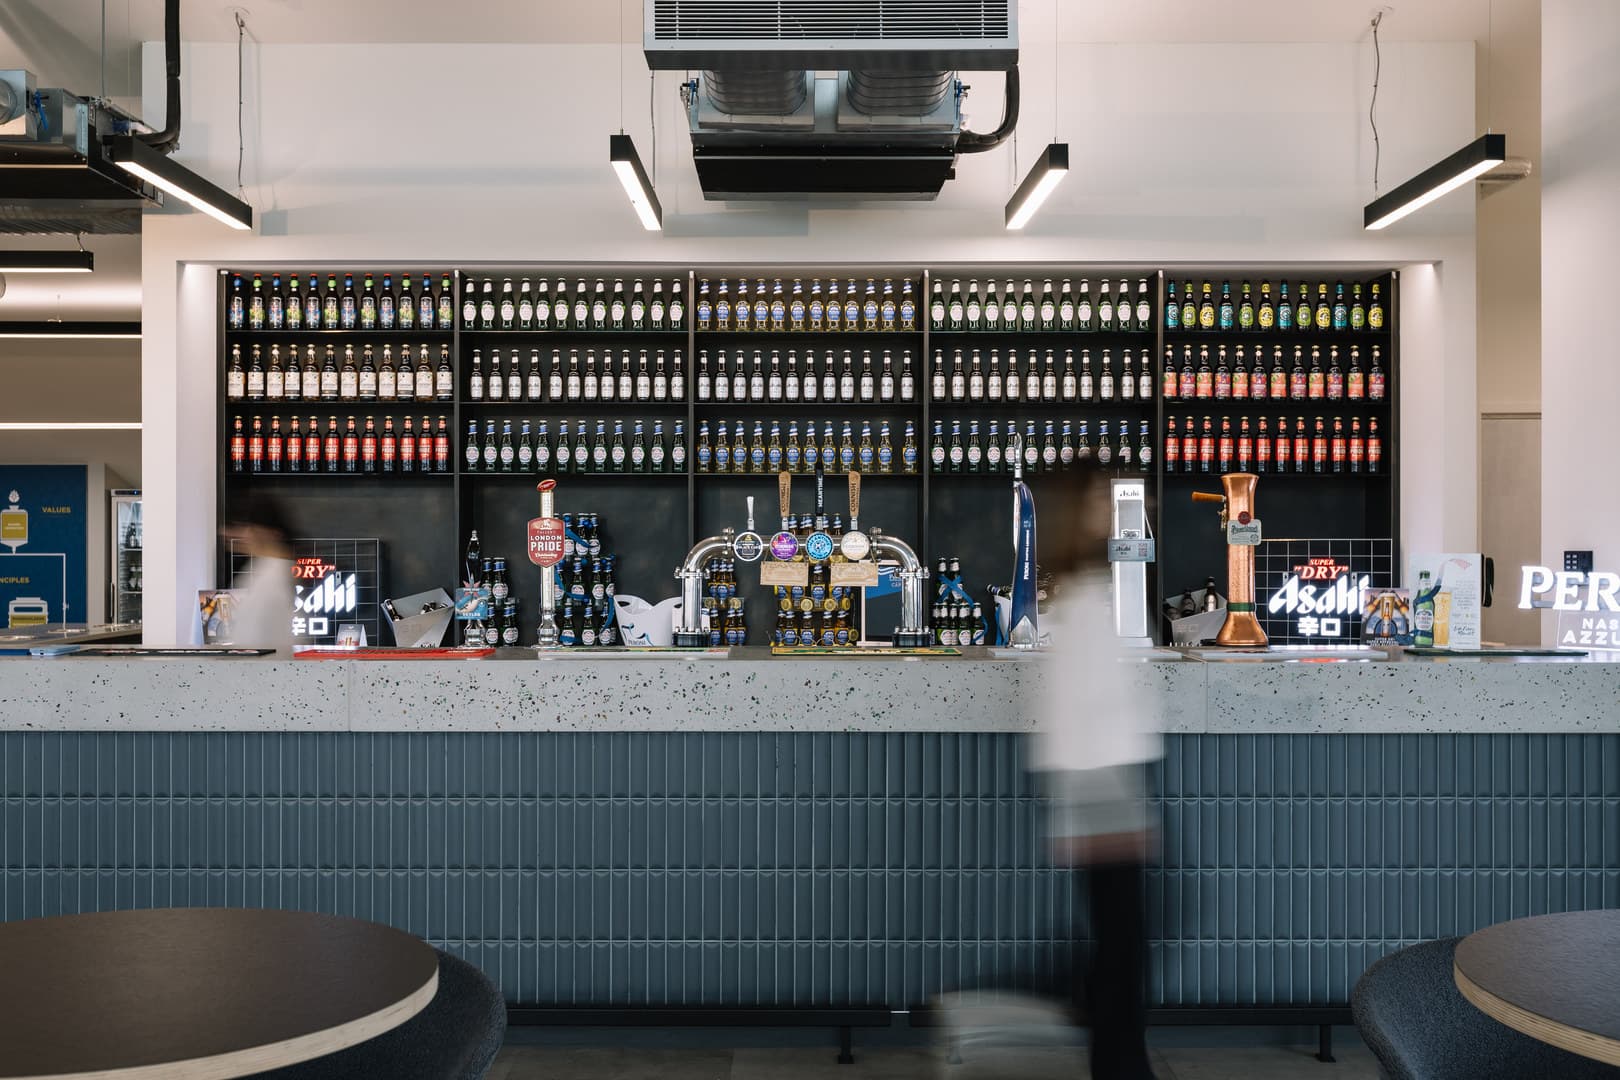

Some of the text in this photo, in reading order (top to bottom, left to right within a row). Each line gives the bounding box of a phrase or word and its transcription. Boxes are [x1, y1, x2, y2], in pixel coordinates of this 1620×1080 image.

[530, 541, 562, 552] PRIDE
[1309, 558, 1335, 566] SUPER
[1268, 574, 1370, 615] Asahi
[1582, 617, 1619, 630] NAS
